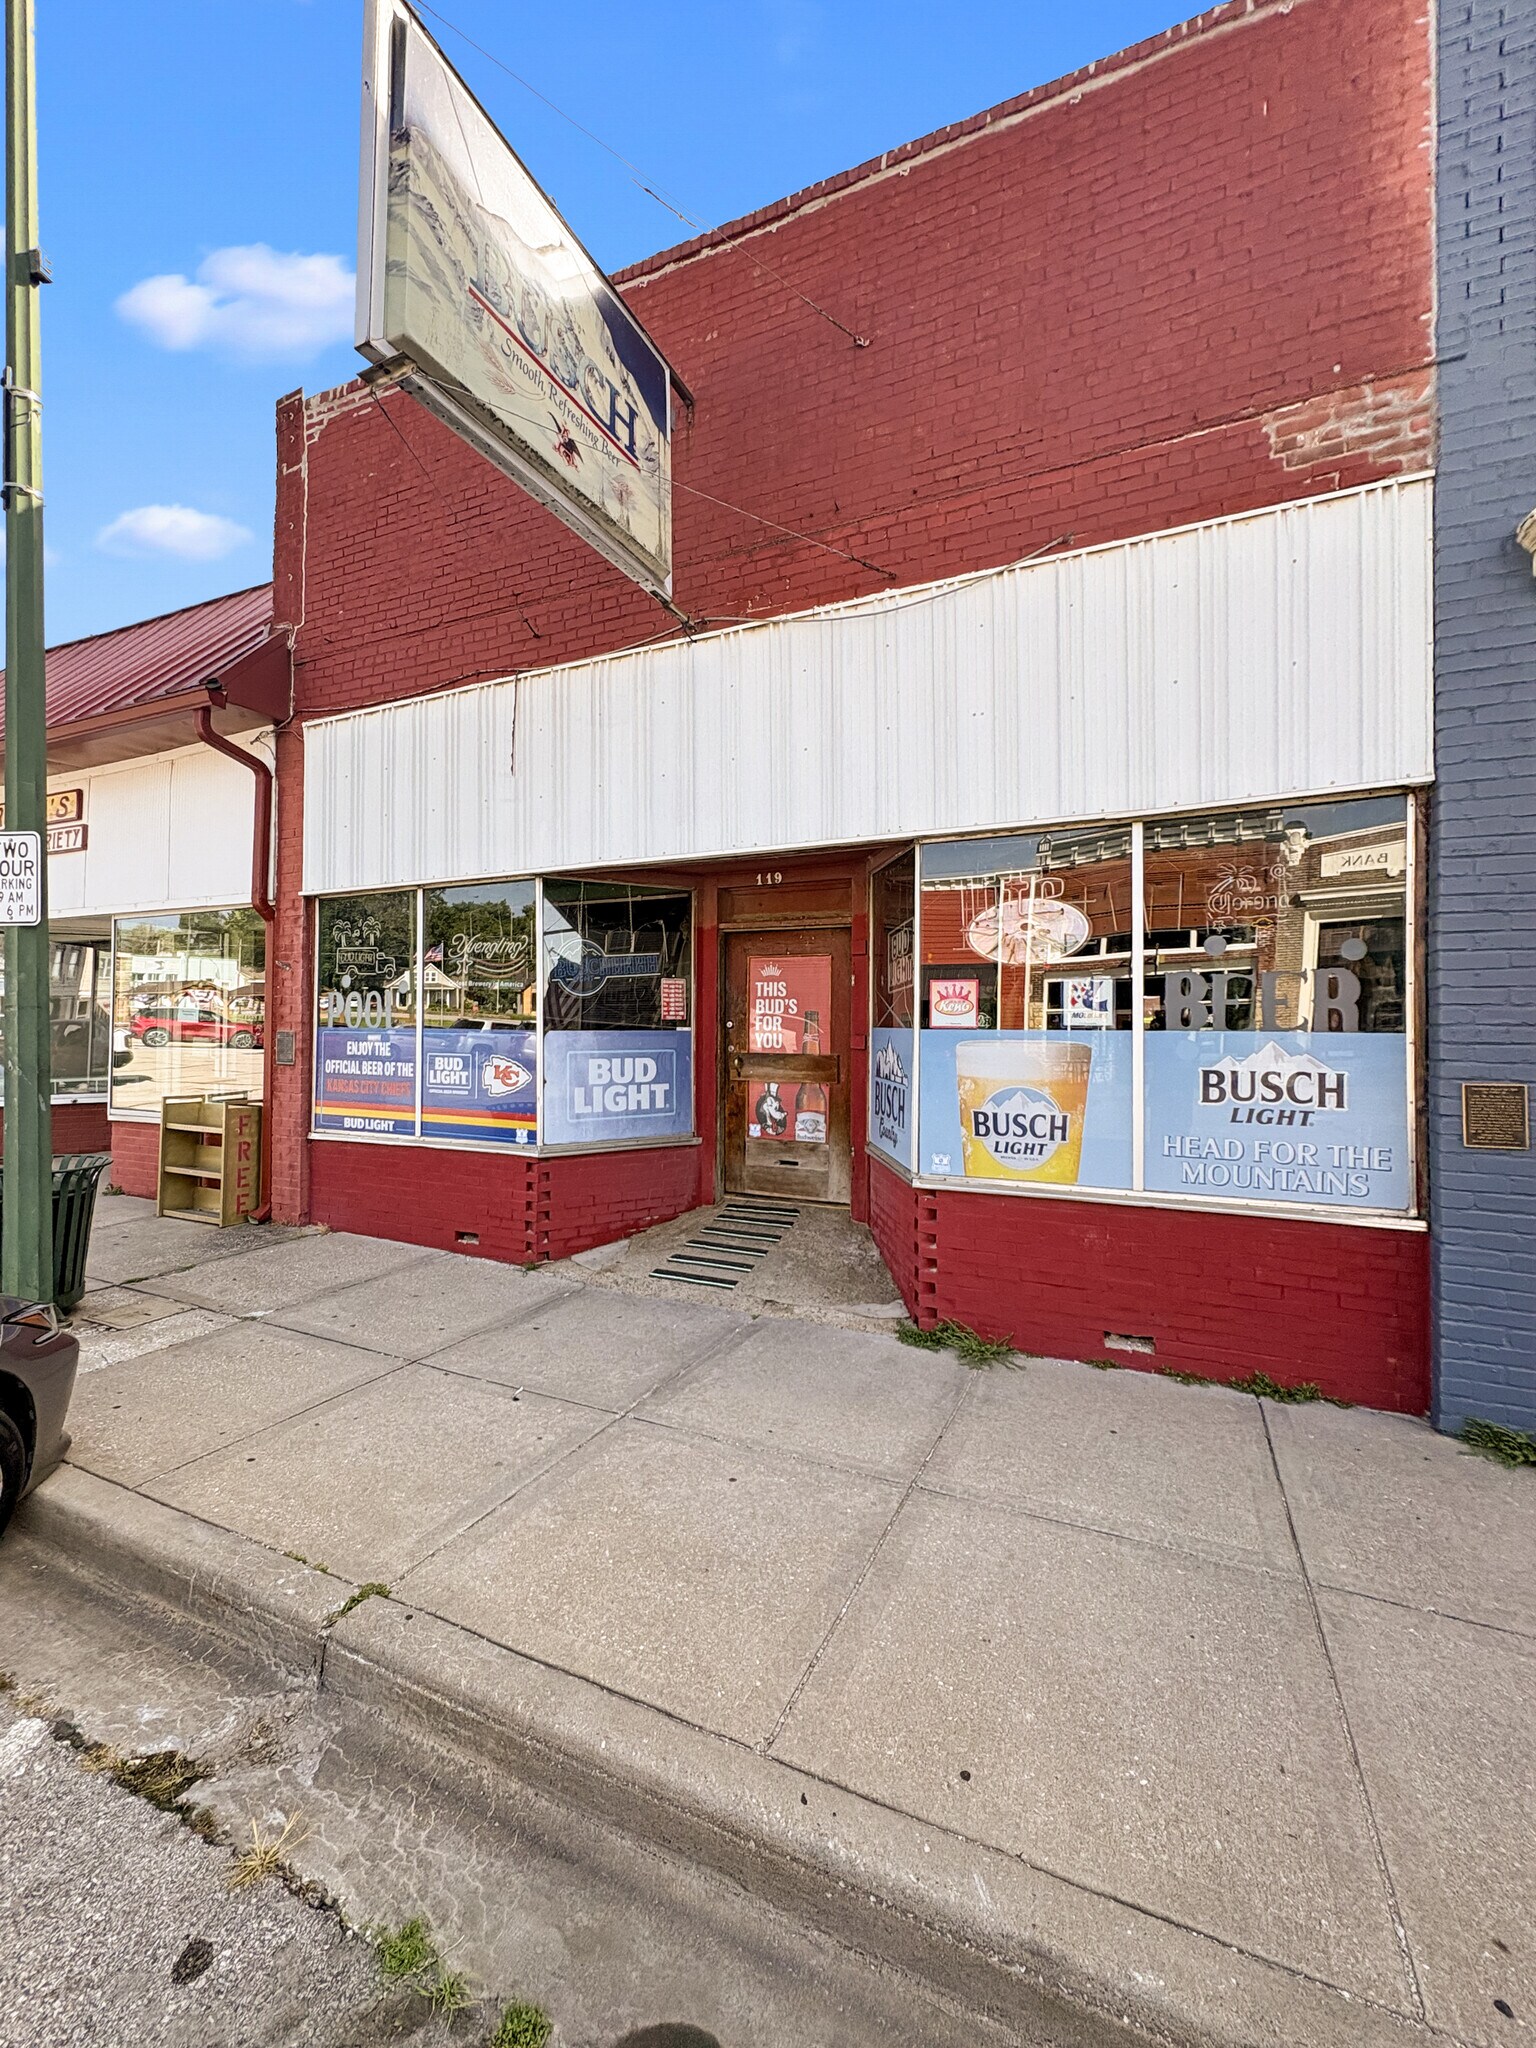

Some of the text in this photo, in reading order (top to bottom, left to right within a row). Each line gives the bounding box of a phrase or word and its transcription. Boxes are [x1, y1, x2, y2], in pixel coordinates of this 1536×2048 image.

[470, 243, 639, 461] BUSCH
[501, 337, 621, 467] Smooth, Refreshing Beer
[47, 828, 81, 849] RIETY
[0, 841, 28, 858] WO
[0, 860, 34, 877] OUR
[0, 878, 32, 890] RKING
[756, 872, 782, 885] 119
[8, 892, 23, 903] AM
[7, 904, 34, 916] 6 PM
[448, 933, 528, 959] Yuengling
[891, 927, 909, 961] BUD
[468, 980, 492, 989] Brewery
[500, 981, 524, 989] America
[755, 982, 787, 997] THIS
[755, 999, 798, 1014] BUD'S
[1165, 967, 1361, 1032] BEER
[755, 1016, 782, 1031] FOR
[346, 1041, 391, 1056] ENJOY THE
[755, 1033, 783, 1049] YOU
[325, 1059, 415, 1077] OFFICIAL BEER OF THE
[434, 1056, 463, 1071] BUD
[588, 1057, 657, 1085] BUD
[429, 1070, 468, 1085] LIGHT
[493, 1064, 519, 1087] KC
[326, 1078, 360, 1093] KANSAS
[361, 1080, 378, 1094] CITY
[381, 1080, 411, 1097] CHIEFS
[1201, 1069, 1345, 1109] BUSCH
[574, 1083, 669, 1114] LIGHT
[874, 1081, 905, 1130] BUSCH
[343, 1117, 395, 1131] BUD LIGHT
[973, 1110, 1068, 1142] BUSCH
[1230, 1107, 1315, 1127] LIGHT
[993, 1141, 1048, 1156] LIGHT
[1163, 1134, 1393, 1171] HEAD FOR THE
[236, 1115, 252, 1216] FREE
[1181, 1162, 1370, 1197] MOUNTAINS
